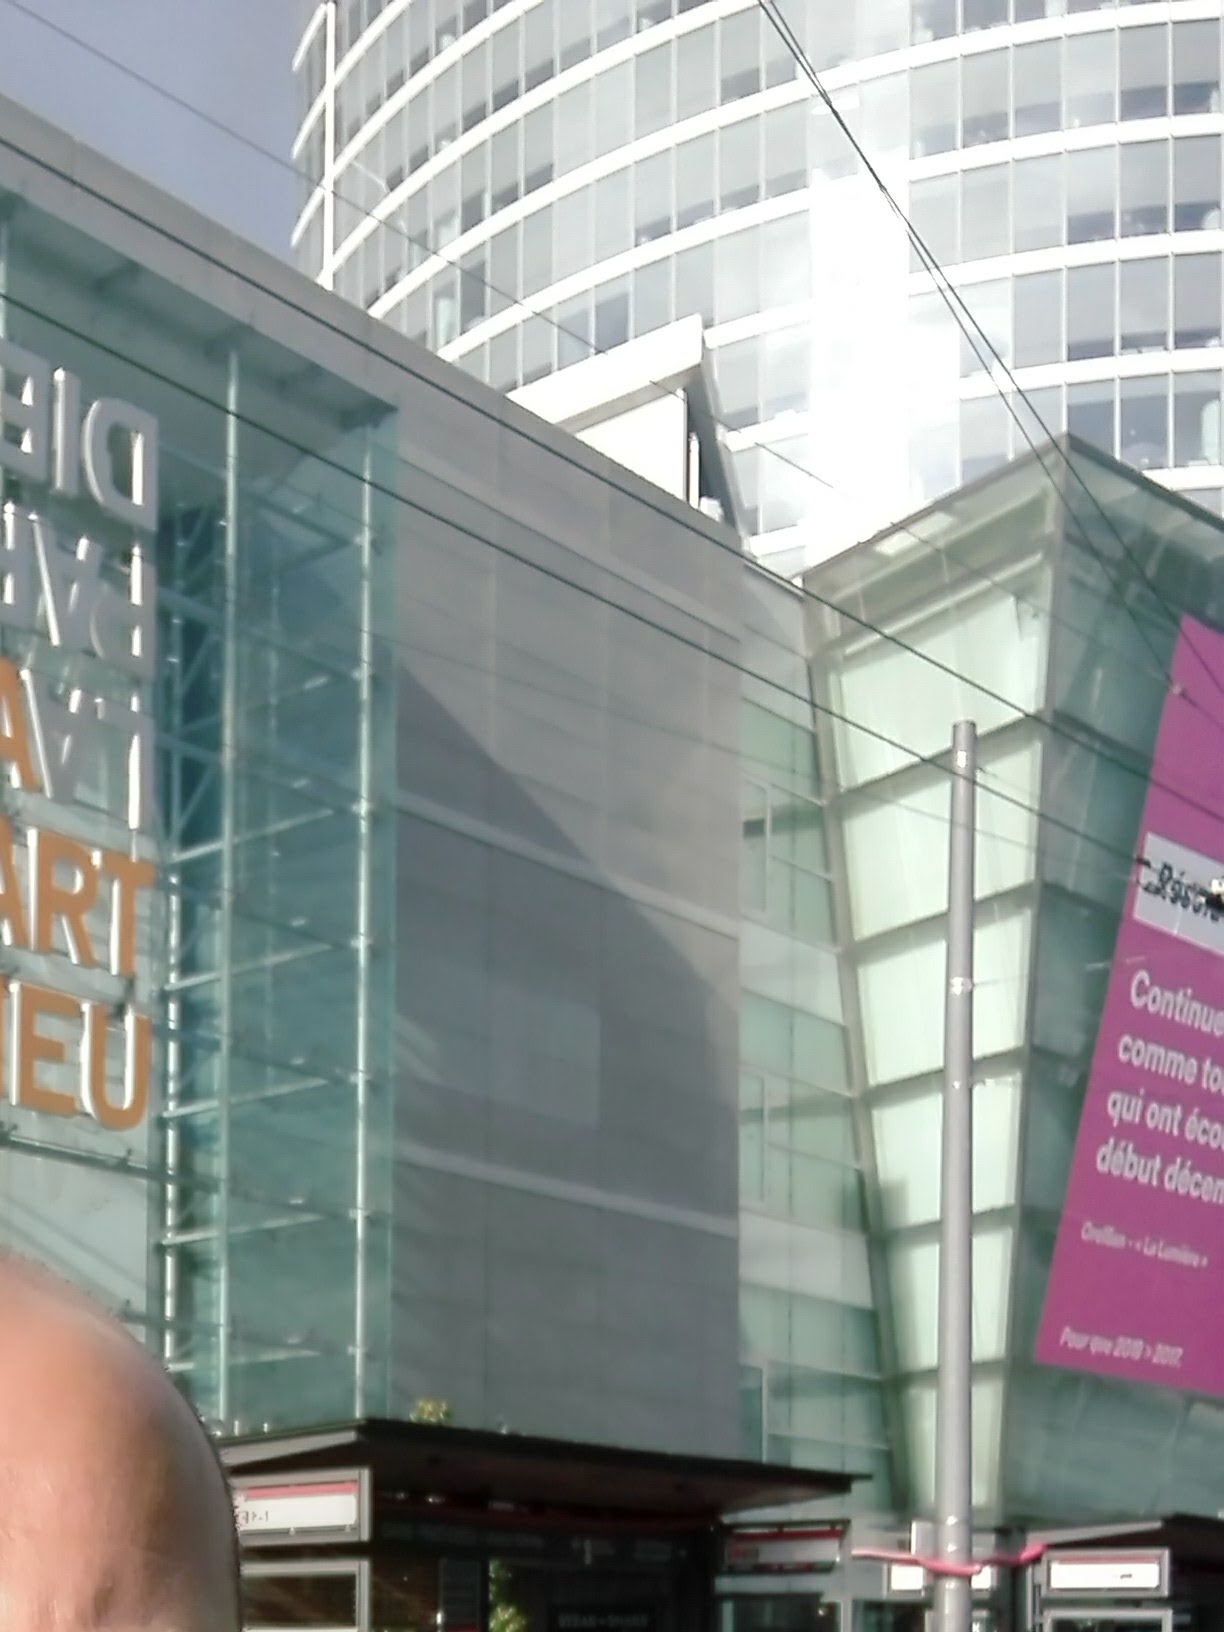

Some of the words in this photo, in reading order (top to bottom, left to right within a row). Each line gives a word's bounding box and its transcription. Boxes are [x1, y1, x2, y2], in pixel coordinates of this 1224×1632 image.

[1118, 1034, 1198, 1085] comme
[1202, 1056, 1224, 1096] to
[1107, 1087, 1145, 1128] qui
[1146, 1102, 1182, 1137] ont
[1184, 1107, 1224, 1152] éco
[1096, 1137, 1162, 1187] début
